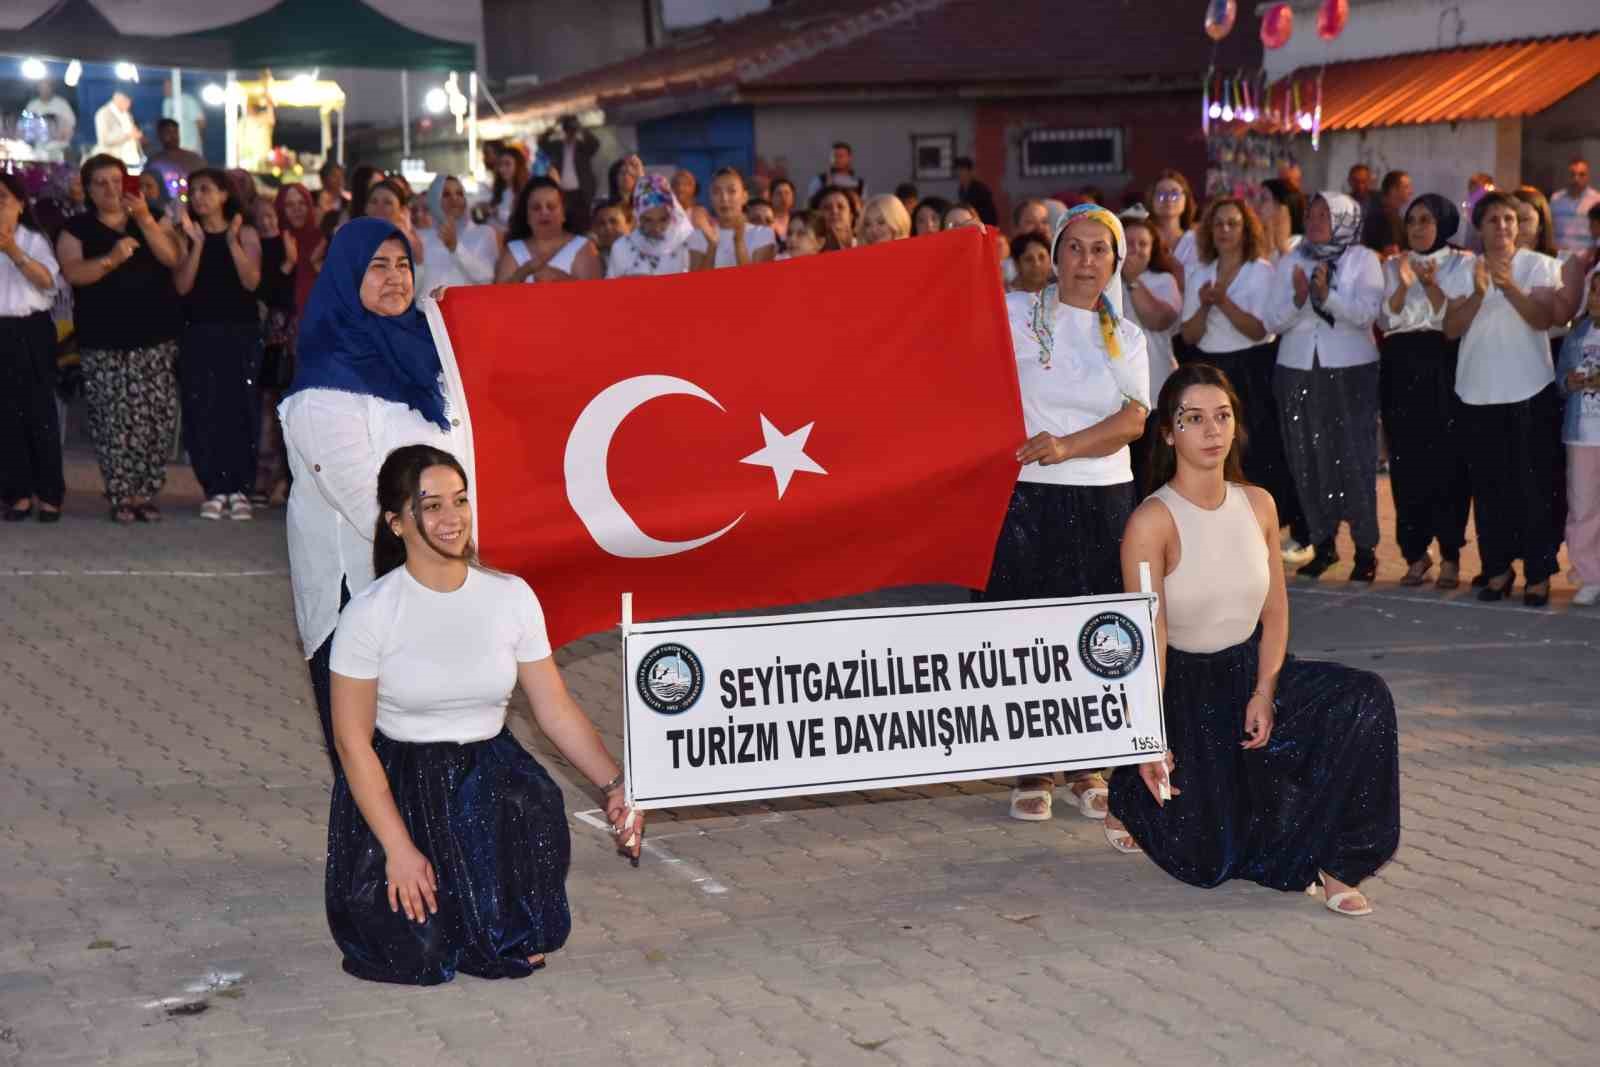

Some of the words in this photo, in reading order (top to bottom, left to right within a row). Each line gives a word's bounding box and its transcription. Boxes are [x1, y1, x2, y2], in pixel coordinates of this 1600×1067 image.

[718, 647, 952, 709] SEYİTGAZİLİLER
[958, 636, 1073, 690] KÜLTÜR
[666, 715, 779, 769] TURİZM
[786, 717, 826, 759] VE
[834, 704, 1000, 757] DAYANIŞMA
[1005, 683, 1132, 740] DERNEĞİ
